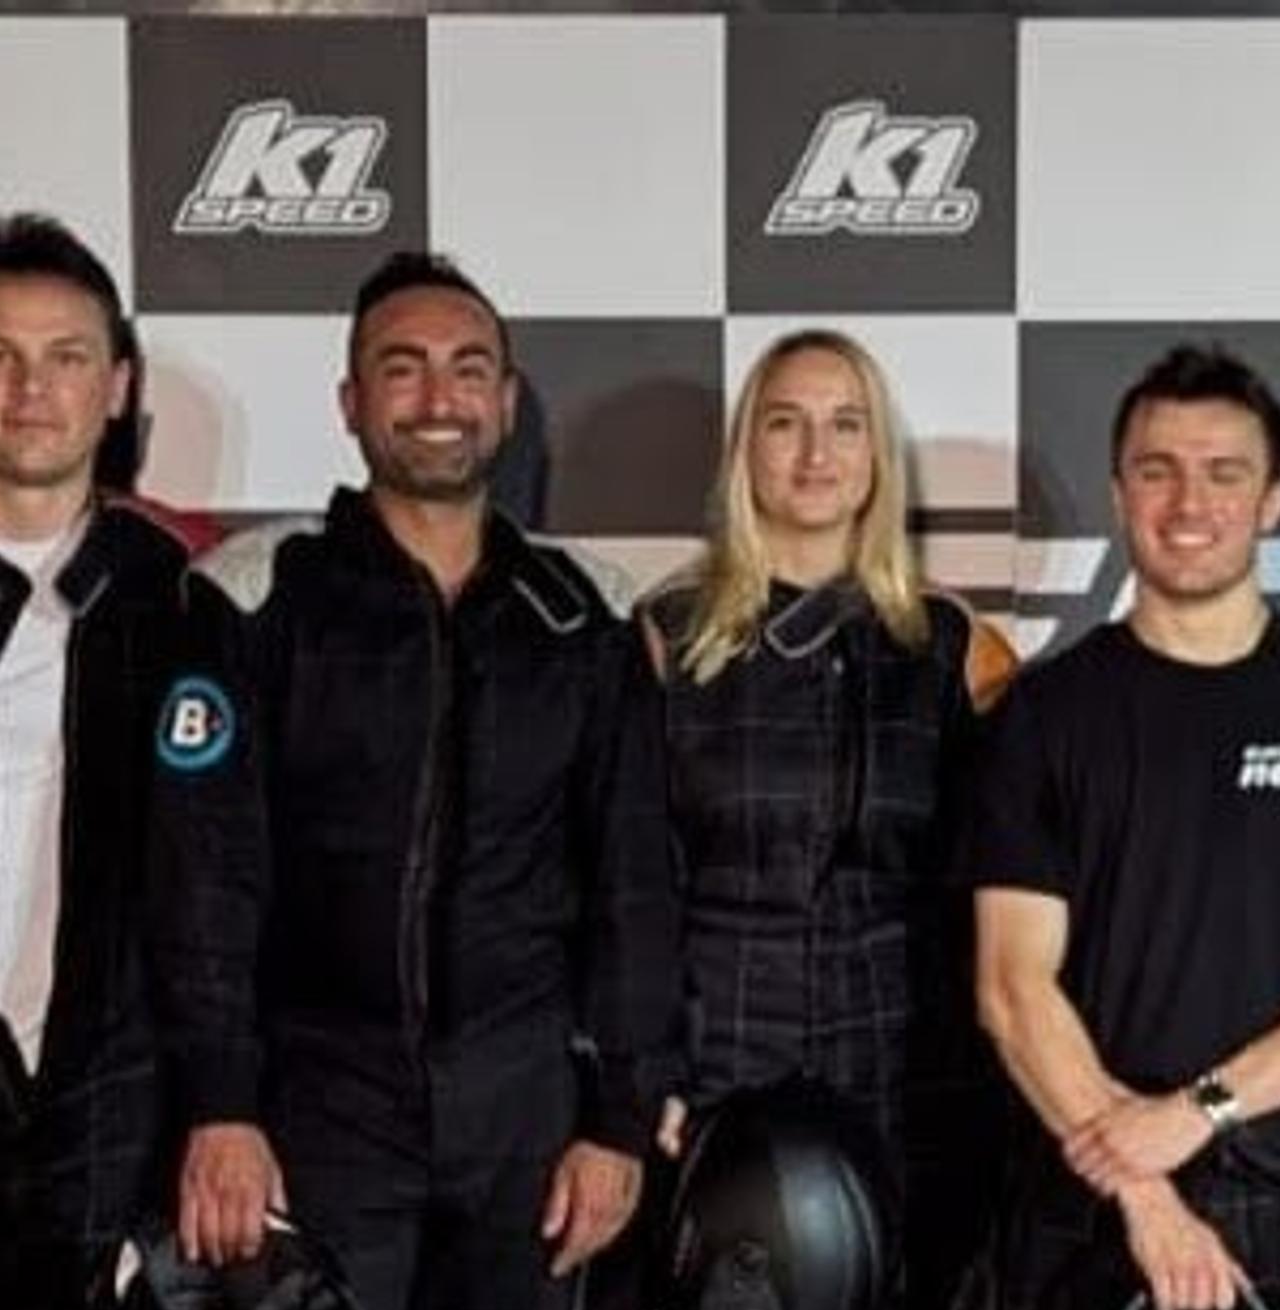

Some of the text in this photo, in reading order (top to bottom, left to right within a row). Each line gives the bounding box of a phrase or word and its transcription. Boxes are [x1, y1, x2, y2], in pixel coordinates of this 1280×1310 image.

[208, 110, 376, 197] K1
[794, 110, 963, 197] K1
[189, 200, 381, 222] SPEED
[781, 200, 971, 222] SPEED
[171, 699, 207, 745] B
